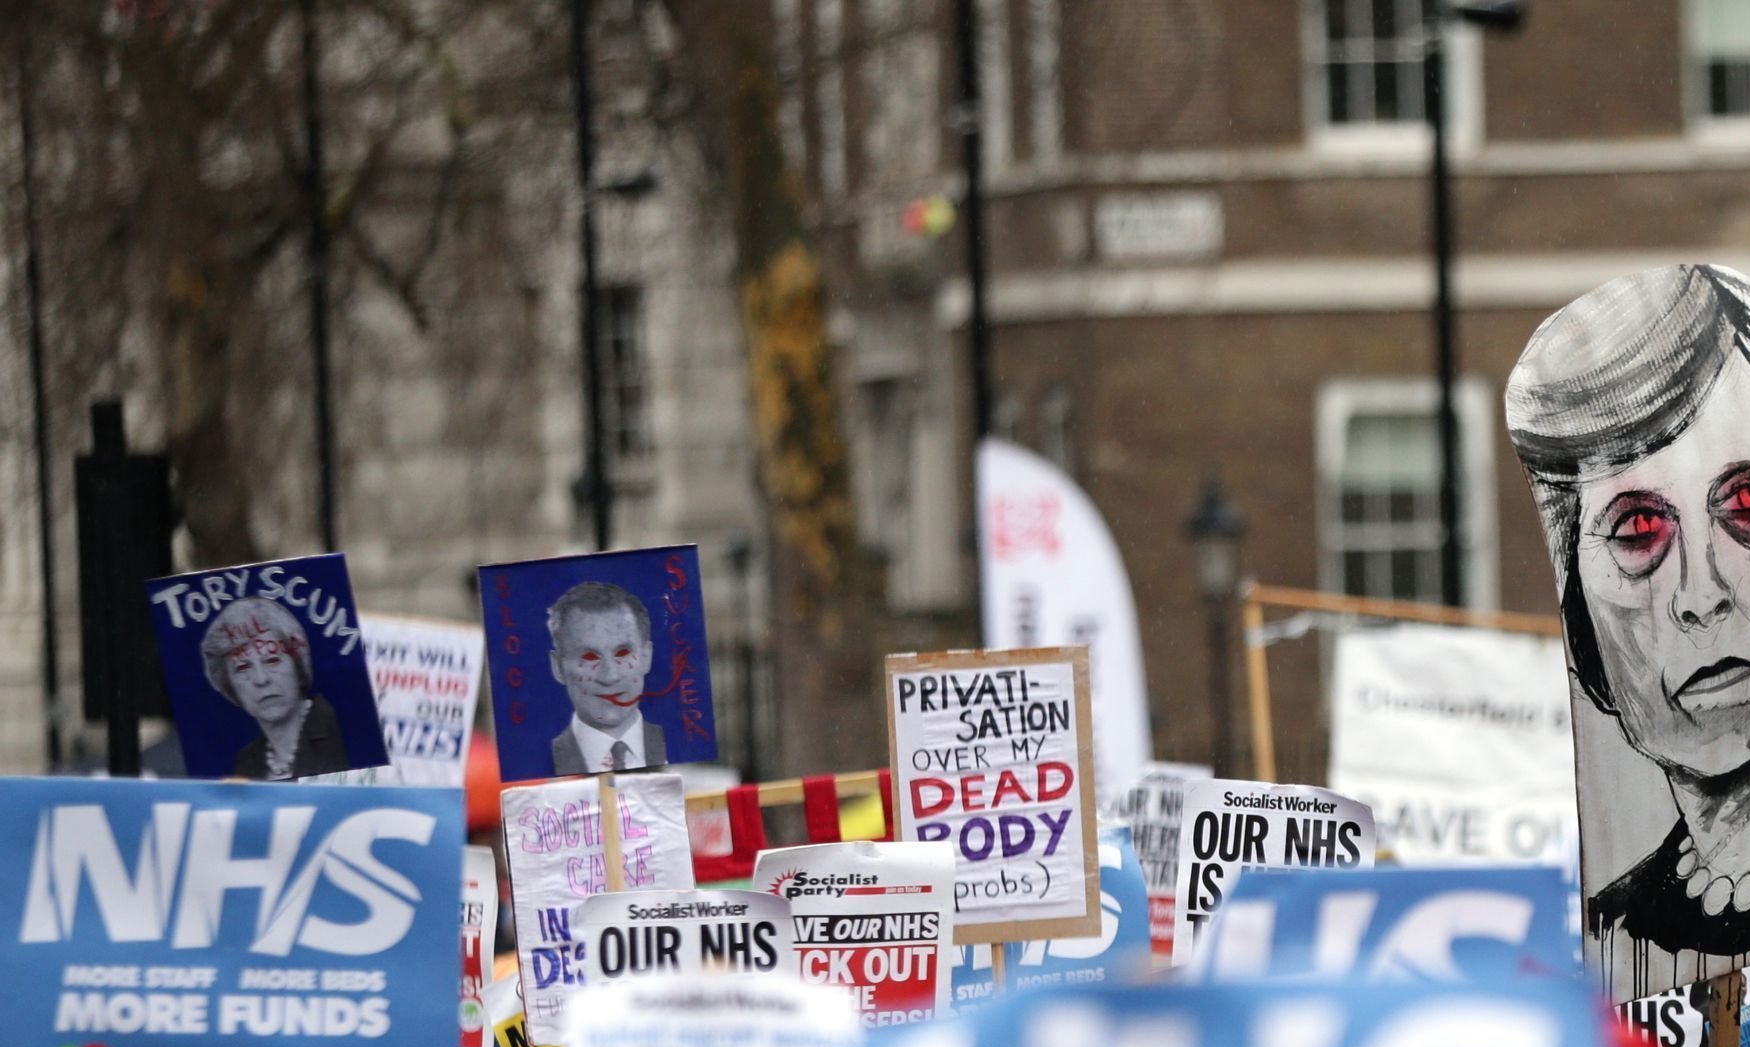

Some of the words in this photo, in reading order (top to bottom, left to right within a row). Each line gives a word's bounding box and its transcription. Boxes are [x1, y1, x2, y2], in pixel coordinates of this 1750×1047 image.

[152, 568, 250, 628] TORY
[259, 566, 360, 655] SCUM
[376, 670, 469, 698] UNPLUG
[897, 668, 1040, 713] PRIVATI-
[956, 700, 1070, 742] SATION
[912, 746, 991, 773] OVER
[1012, 735, 1046, 762] MY
[910, 761, 1075, 819] DEAD
[1224, 791, 1283, 811] Socialist
[1285, 796, 1338, 814] Worker
[1193, 811, 1269, 863] OUR
[1284, 817, 1362, 869] NHS
[20, 803, 436, 956] NHS
[793, 872, 878, 887] Socialist
[1187, 862, 1224, 913] IS
[538, 907, 571, 943] IN
[628, 904, 696, 920] Socialist
[696, 903, 749, 917] Worker
[833, 916, 883, 940] OUR
[885, 913, 939, 939] NHS
[600, 925, 681, 978] OUR
[699, 921, 778, 974] NHS
[801, 949, 855, 984] CK
[863, 947, 936, 982] OUT
[63, 966, 142, 988] MORE
[146, 967, 218, 989] STAFF
[239, 969, 317, 991] MORE
[321, 970, 387, 993] BEDS
[55, 992, 209, 1034] MORE
[219, 994, 392, 1038] FUNDS
